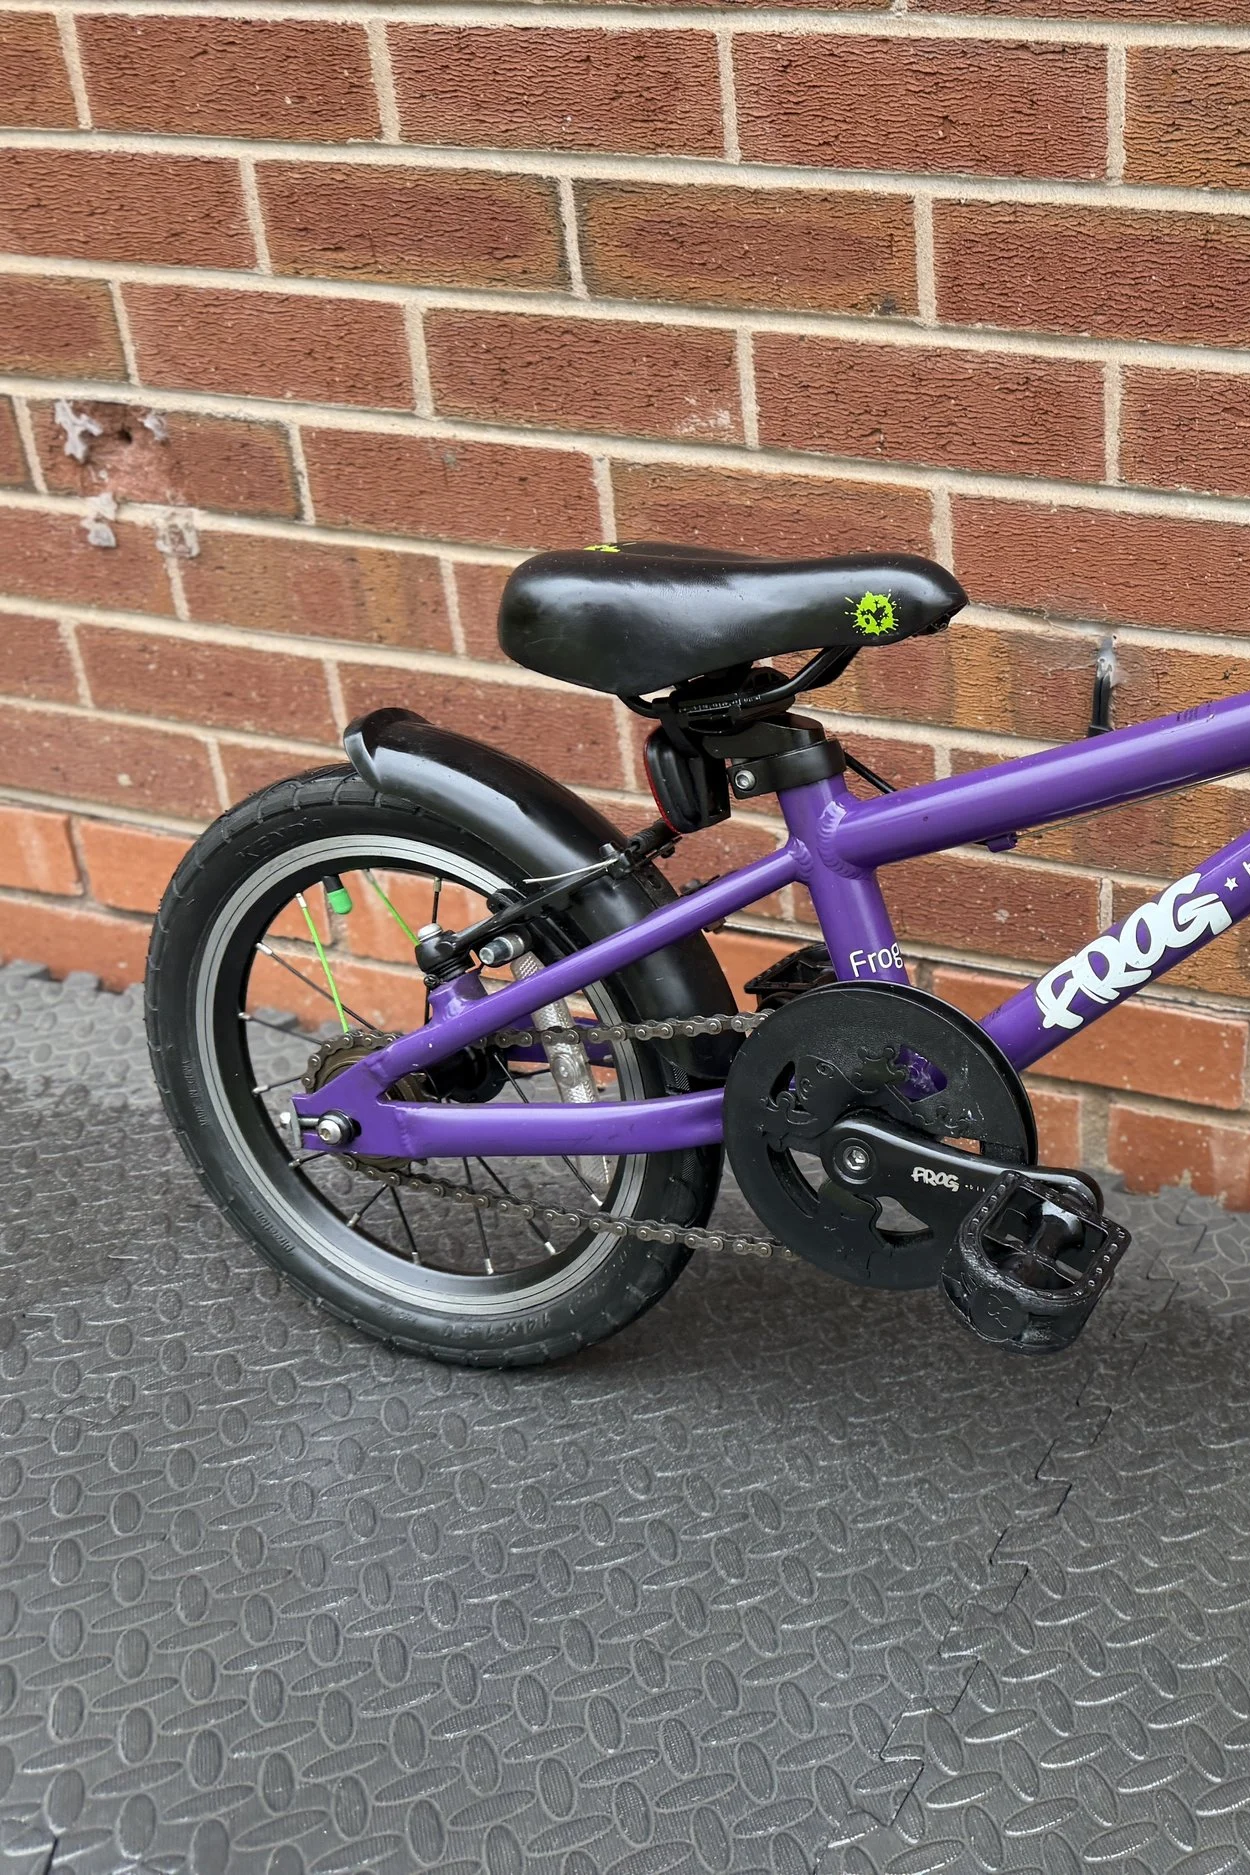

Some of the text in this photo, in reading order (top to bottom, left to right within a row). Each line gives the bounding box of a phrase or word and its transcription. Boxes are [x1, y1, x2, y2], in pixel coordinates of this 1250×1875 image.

[849, 941, 904, 978] Frog
[1035, 872, 1233, 1030] FROG
[911, 1166, 960, 1191] FROG
